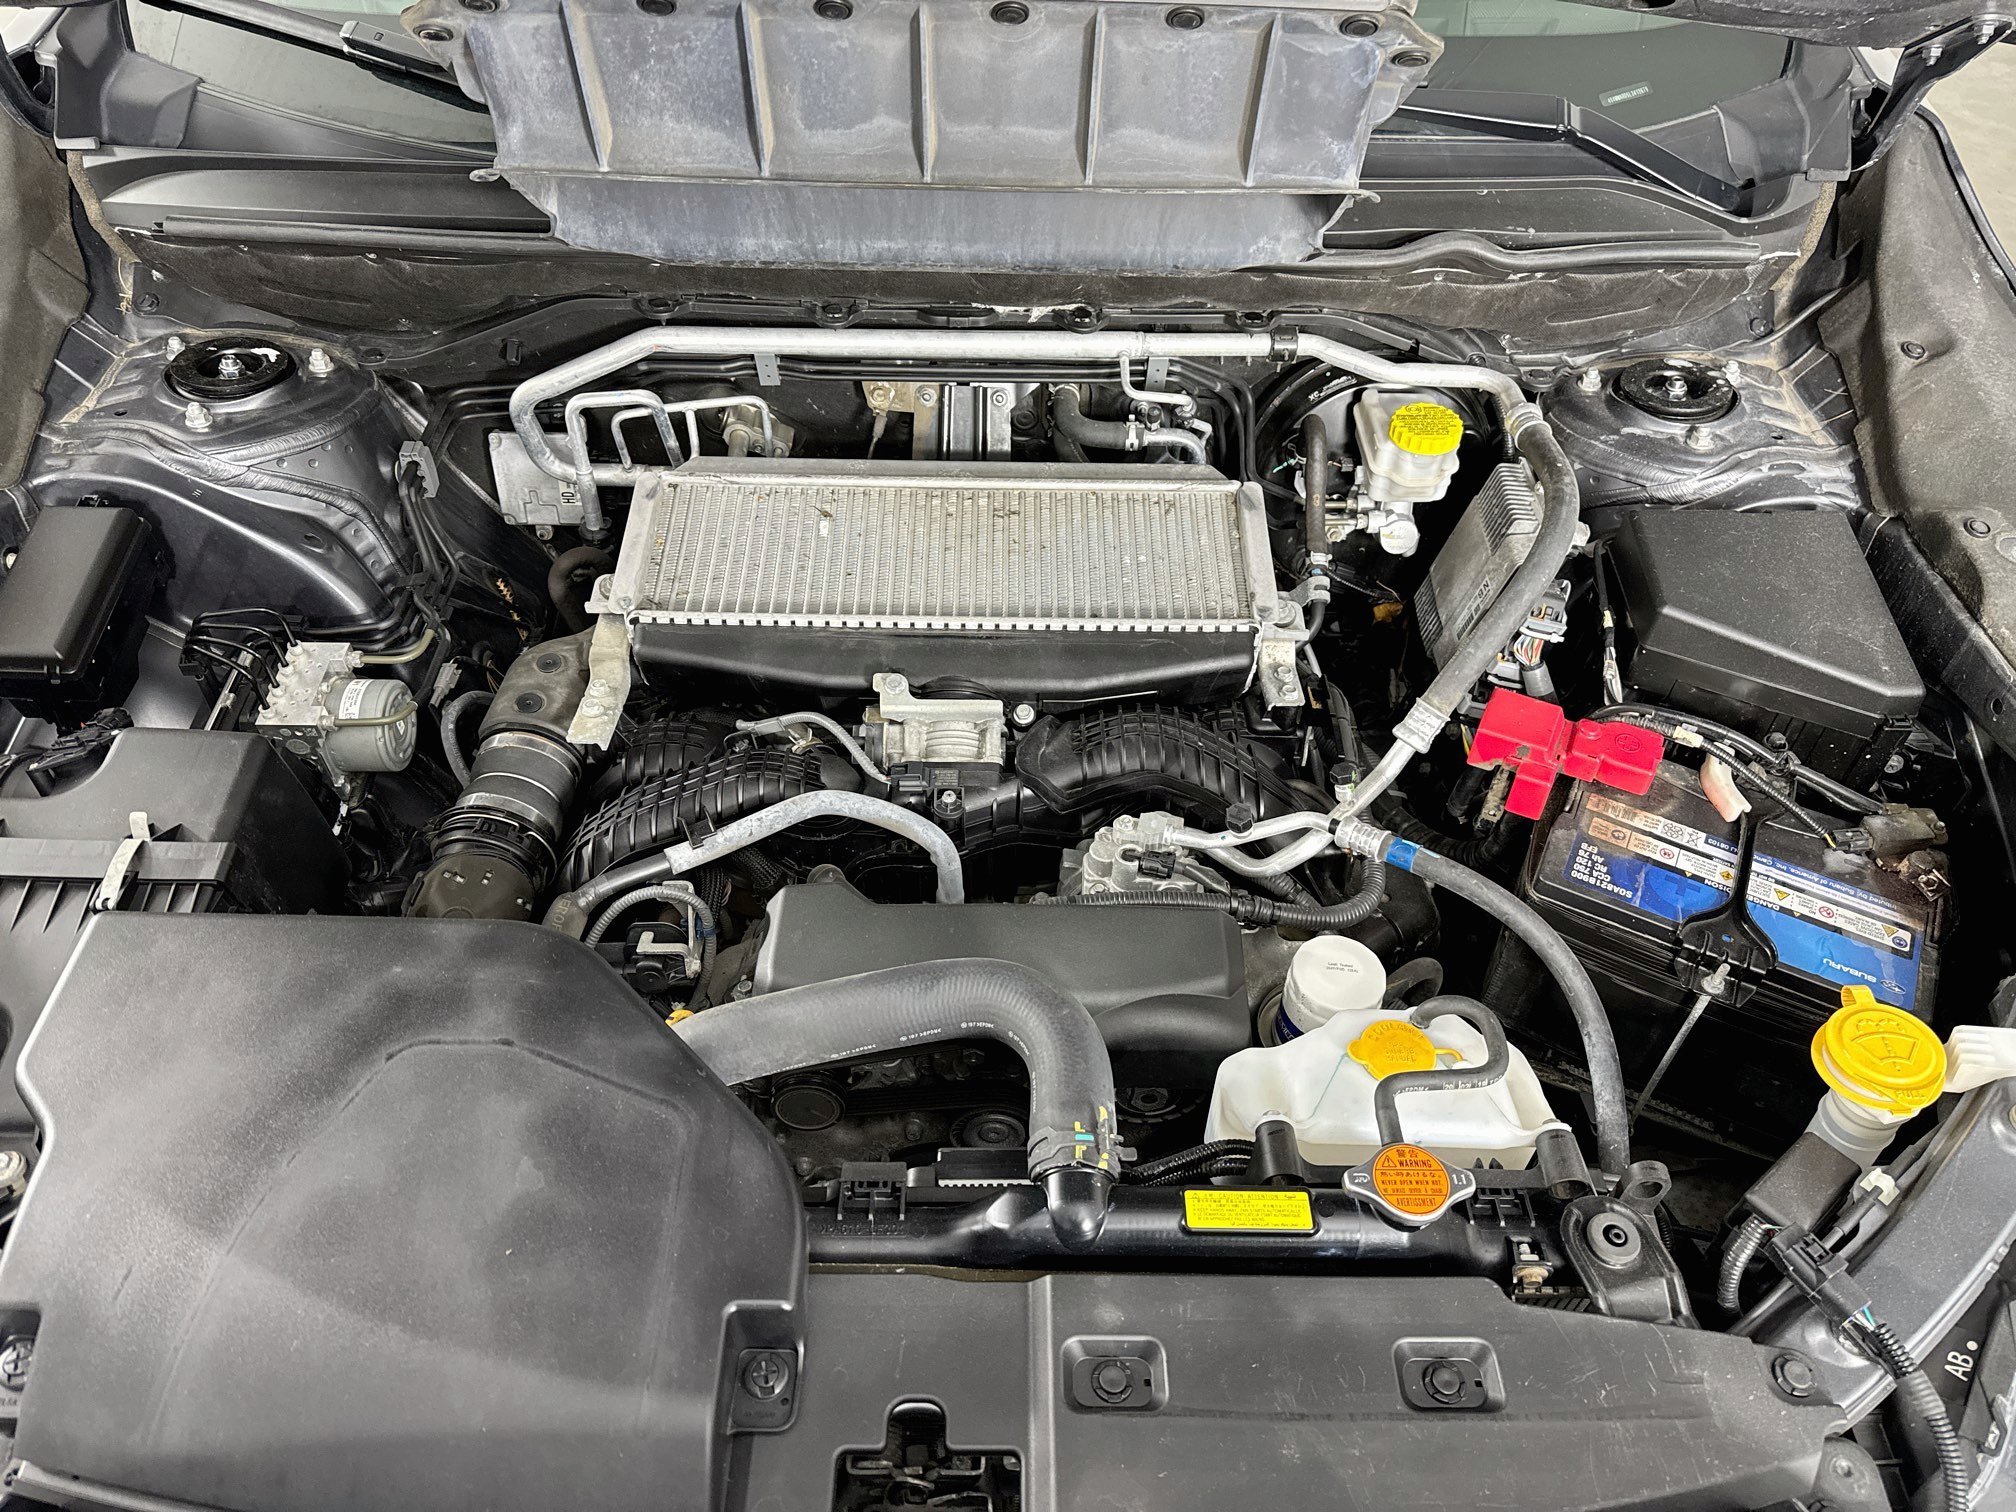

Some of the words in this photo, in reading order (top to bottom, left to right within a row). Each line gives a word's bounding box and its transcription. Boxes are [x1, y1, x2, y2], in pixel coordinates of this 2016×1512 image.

[562, 491, 576, 504] HD
[1579, 841, 1598, 853] EFB
[1707, 837, 1729, 849] 08103
[1575, 855, 1593, 867] 120
[1588, 852, 1604, 863] Ah
[1572, 861, 1591, 873] 750
[1592, 861, 1608, 872] RC
[1773, 861, 1787, 870] Inc.
[1591, 868, 1611, 881] CCA
[1703, 878, 1731, 893] OISON
[1828, 881, 1854, 894] Subaru
[1821, 957, 1877, 983] SUBARU
[1396, 1149, 1419, 1158] 警告
[1398, 1159, 1432, 1168] WARNING
[1452, 1174, 1466, 1185] 1.1
[1944, 1351, 1973, 1381] AB
